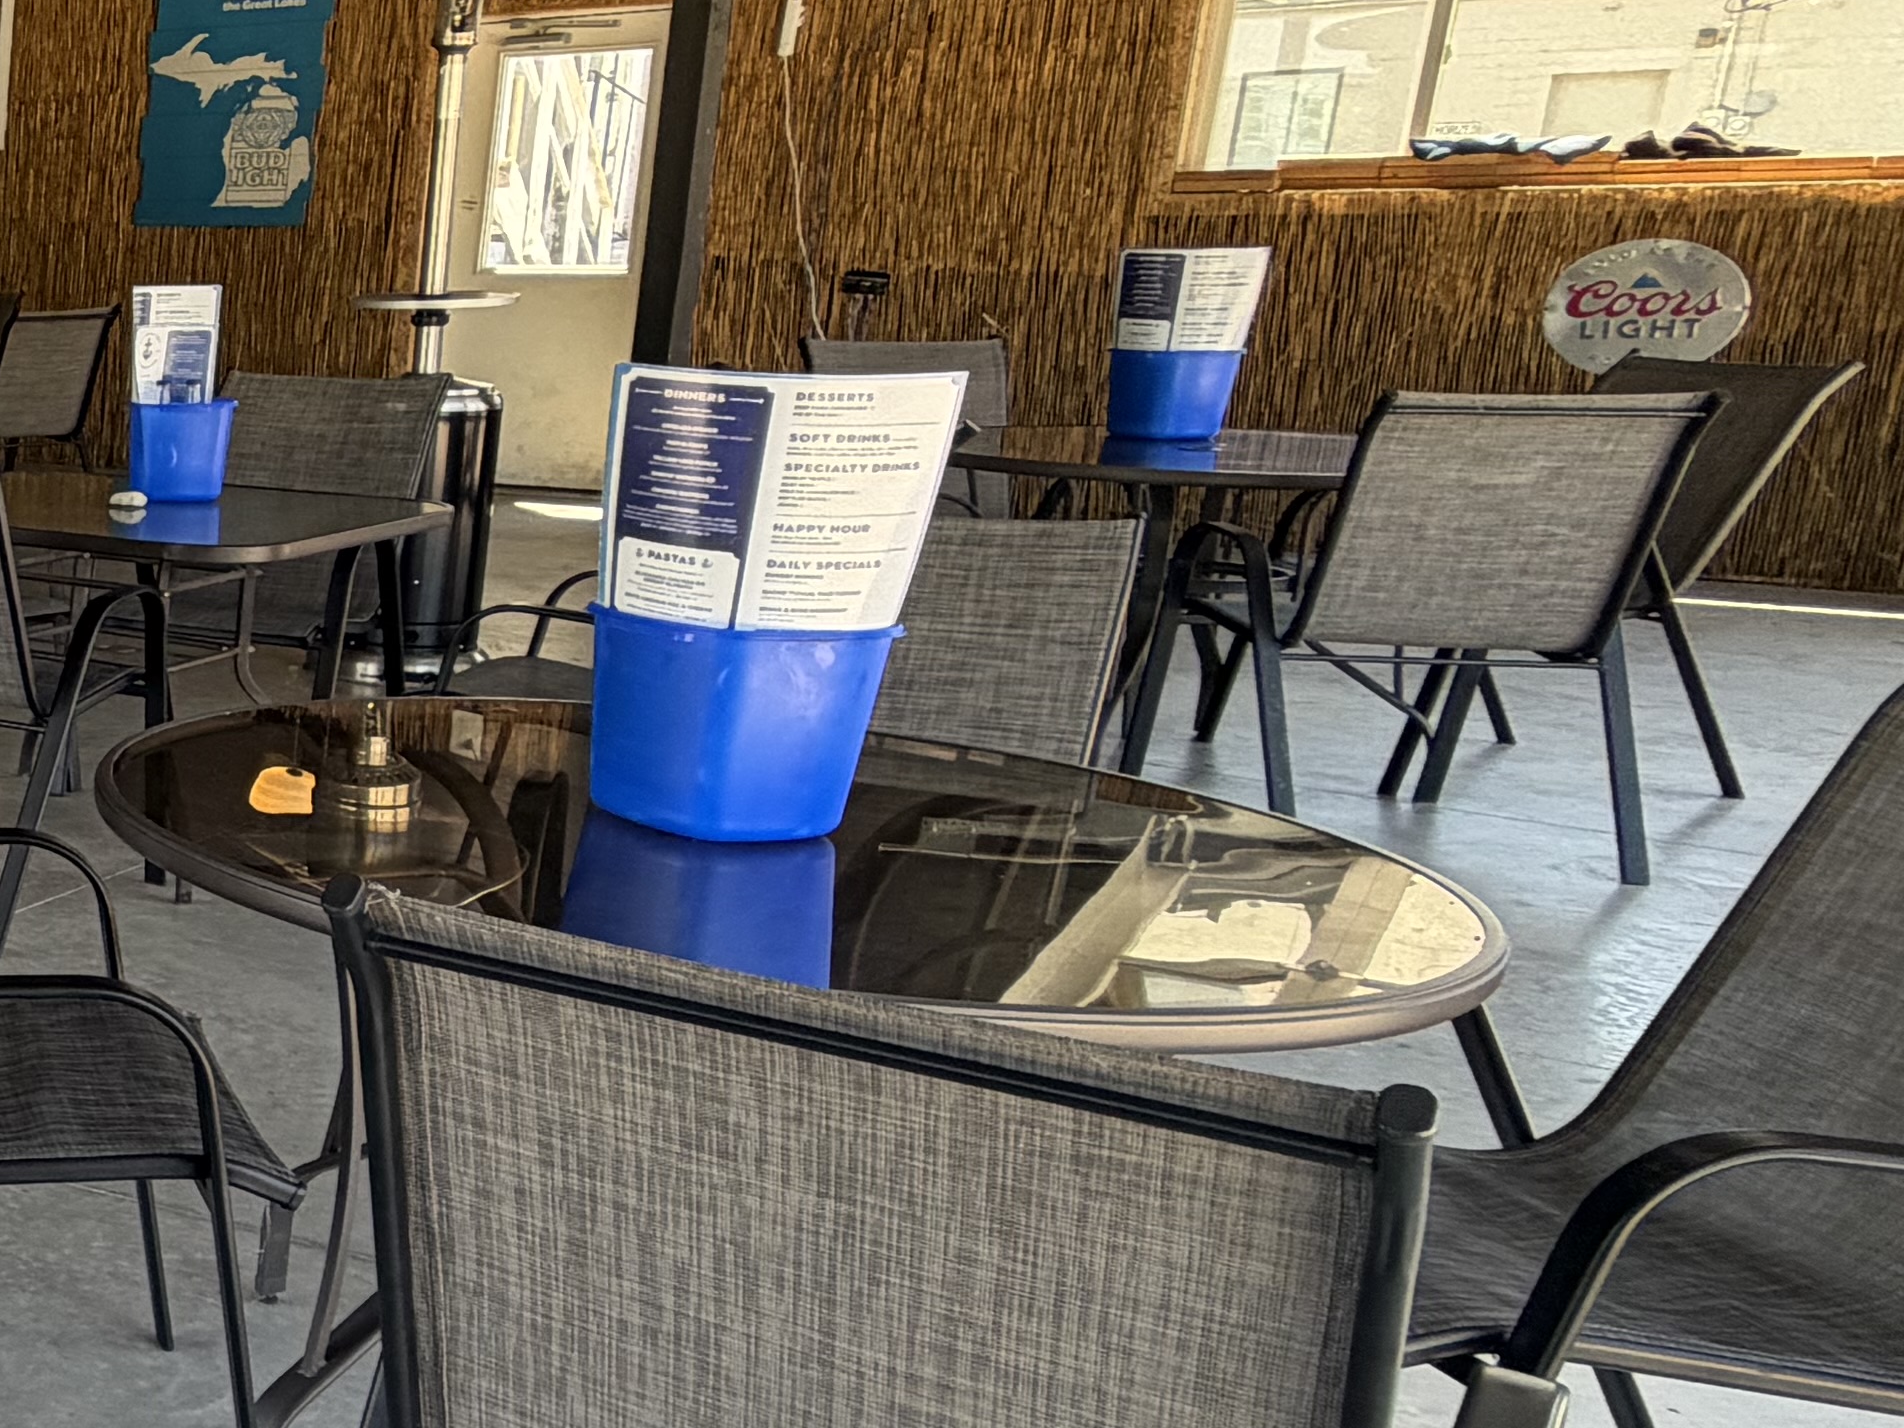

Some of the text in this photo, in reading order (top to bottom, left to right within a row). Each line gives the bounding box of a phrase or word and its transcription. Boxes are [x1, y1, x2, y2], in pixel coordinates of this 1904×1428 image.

[242, 0, 273, 11] Great
[235, 151, 287, 169] BUD
[1565, 279, 1723, 319] Coors
[1578, 318, 1704, 341] LIGHT
[663, 388, 727, 404] DINNERS
[795, 391, 875, 403] DESSERTS
[788, 432, 891, 444] SOFT DRINKS
[783, 461, 921, 474] SPECIALTY DRINKS
[772, 523, 872, 534] HAPPY HOUR
[647, 549, 696, 566] PASTAS
[766, 559, 883, 571] DAILY SPECIALS
